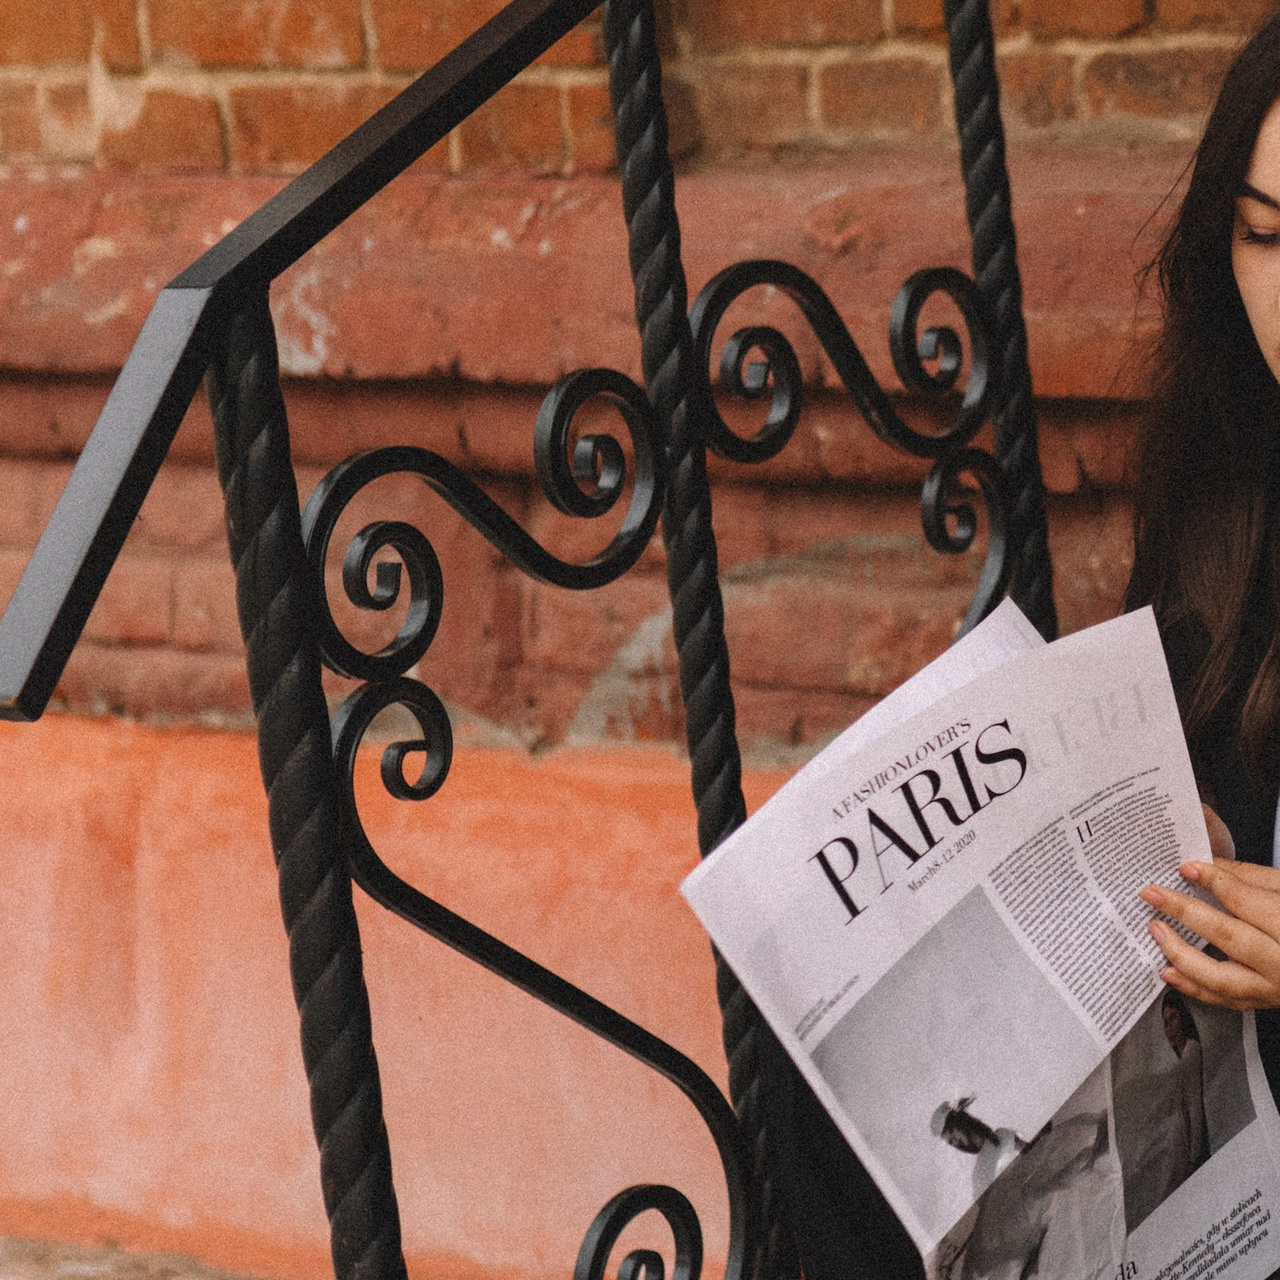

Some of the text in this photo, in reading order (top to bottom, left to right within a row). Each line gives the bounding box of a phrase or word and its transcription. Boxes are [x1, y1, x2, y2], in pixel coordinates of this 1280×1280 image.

[808, 719, 1027, 924] PARIS
[954, 829, 976, 853] 2020
[1221, 1217, 1228, 1226] w
[1230, 1225, 1254, 1248] umiar
[1256, 1210, 1270, 1227] nad
[1216, 1253, 1237, 1274] mimo
